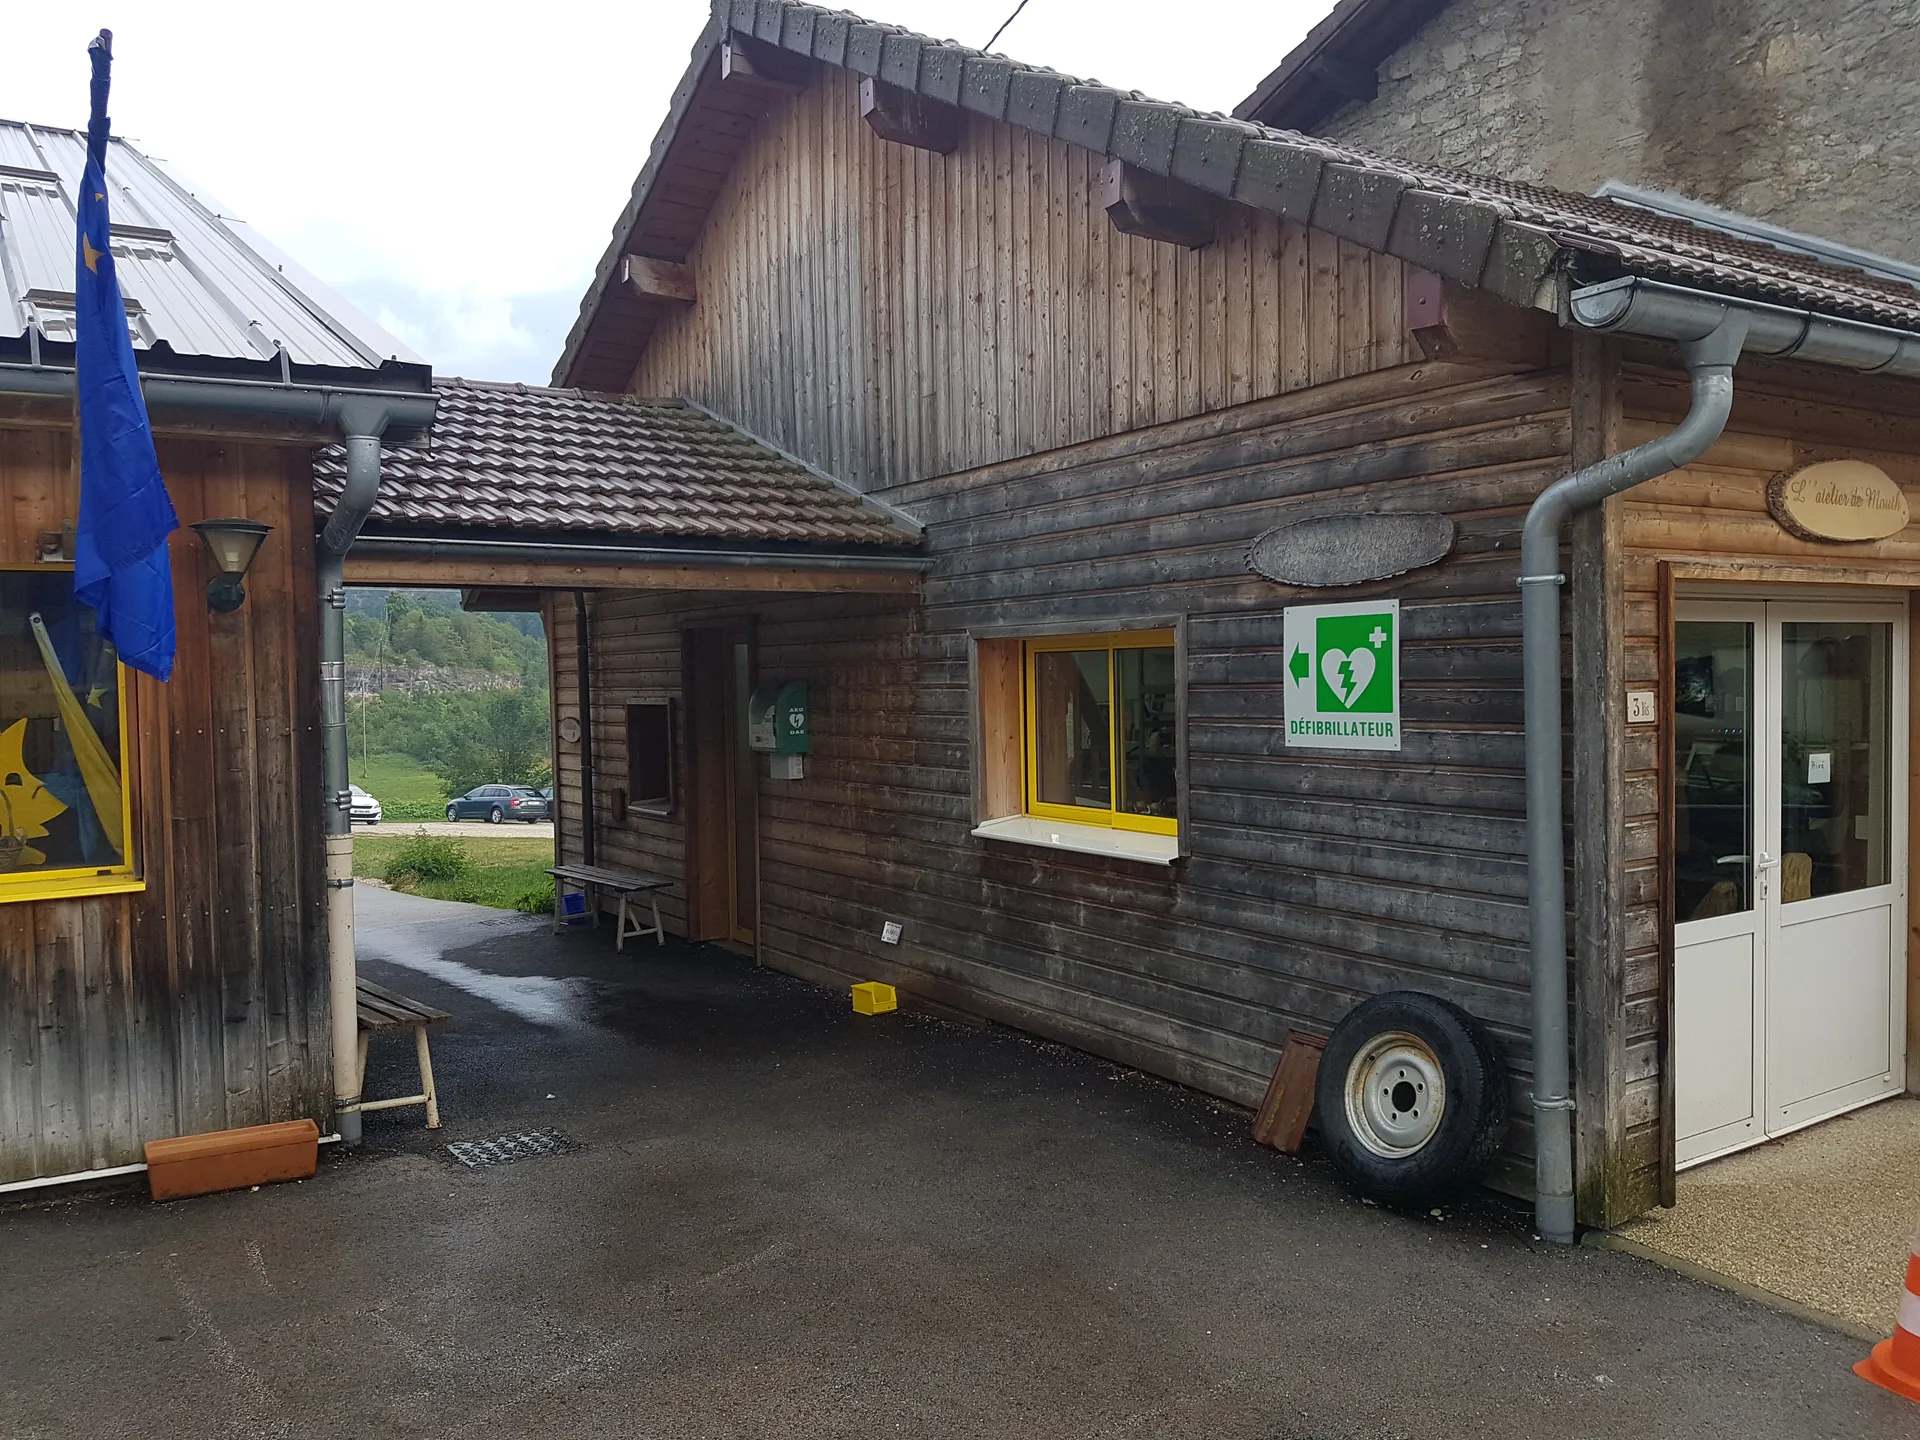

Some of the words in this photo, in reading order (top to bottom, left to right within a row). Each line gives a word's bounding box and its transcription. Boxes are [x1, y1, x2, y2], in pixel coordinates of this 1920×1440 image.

[1850, 487, 1864, 508] de
[1633, 697, 1640, 717] 3
[1290, 717, 1394, 738] DÉFIBRILLATEUR
